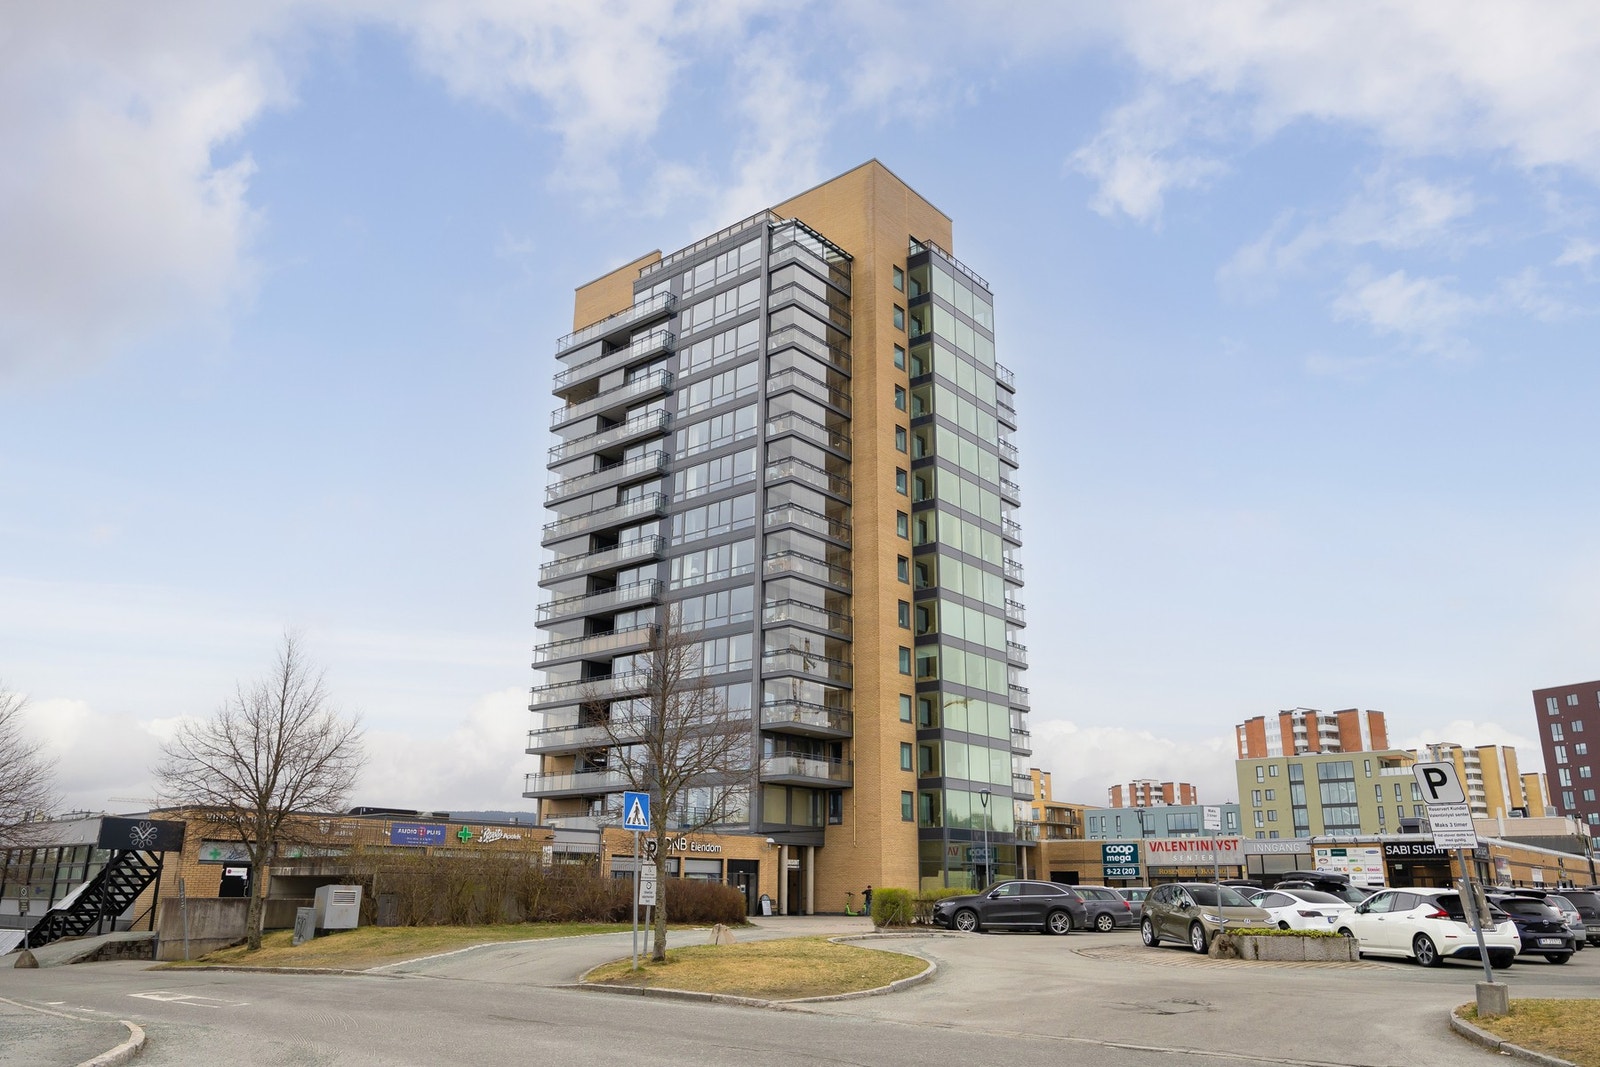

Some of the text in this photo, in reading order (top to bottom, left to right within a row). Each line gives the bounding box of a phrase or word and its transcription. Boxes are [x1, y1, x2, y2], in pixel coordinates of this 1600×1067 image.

[1422, 767, 1448, 799] P
[691, 842, 722, 853] Eiendom
[1106, 845, 1134, 855] coop
[1253, 843, 1300, 852] INNGANG
[1385, 845, 1410, 855] SABI
[1106, 855, 1132, 864] mega
[1173, 854, 1214, 862] SENTER
[1122, 867, 1136, 876] (20)
